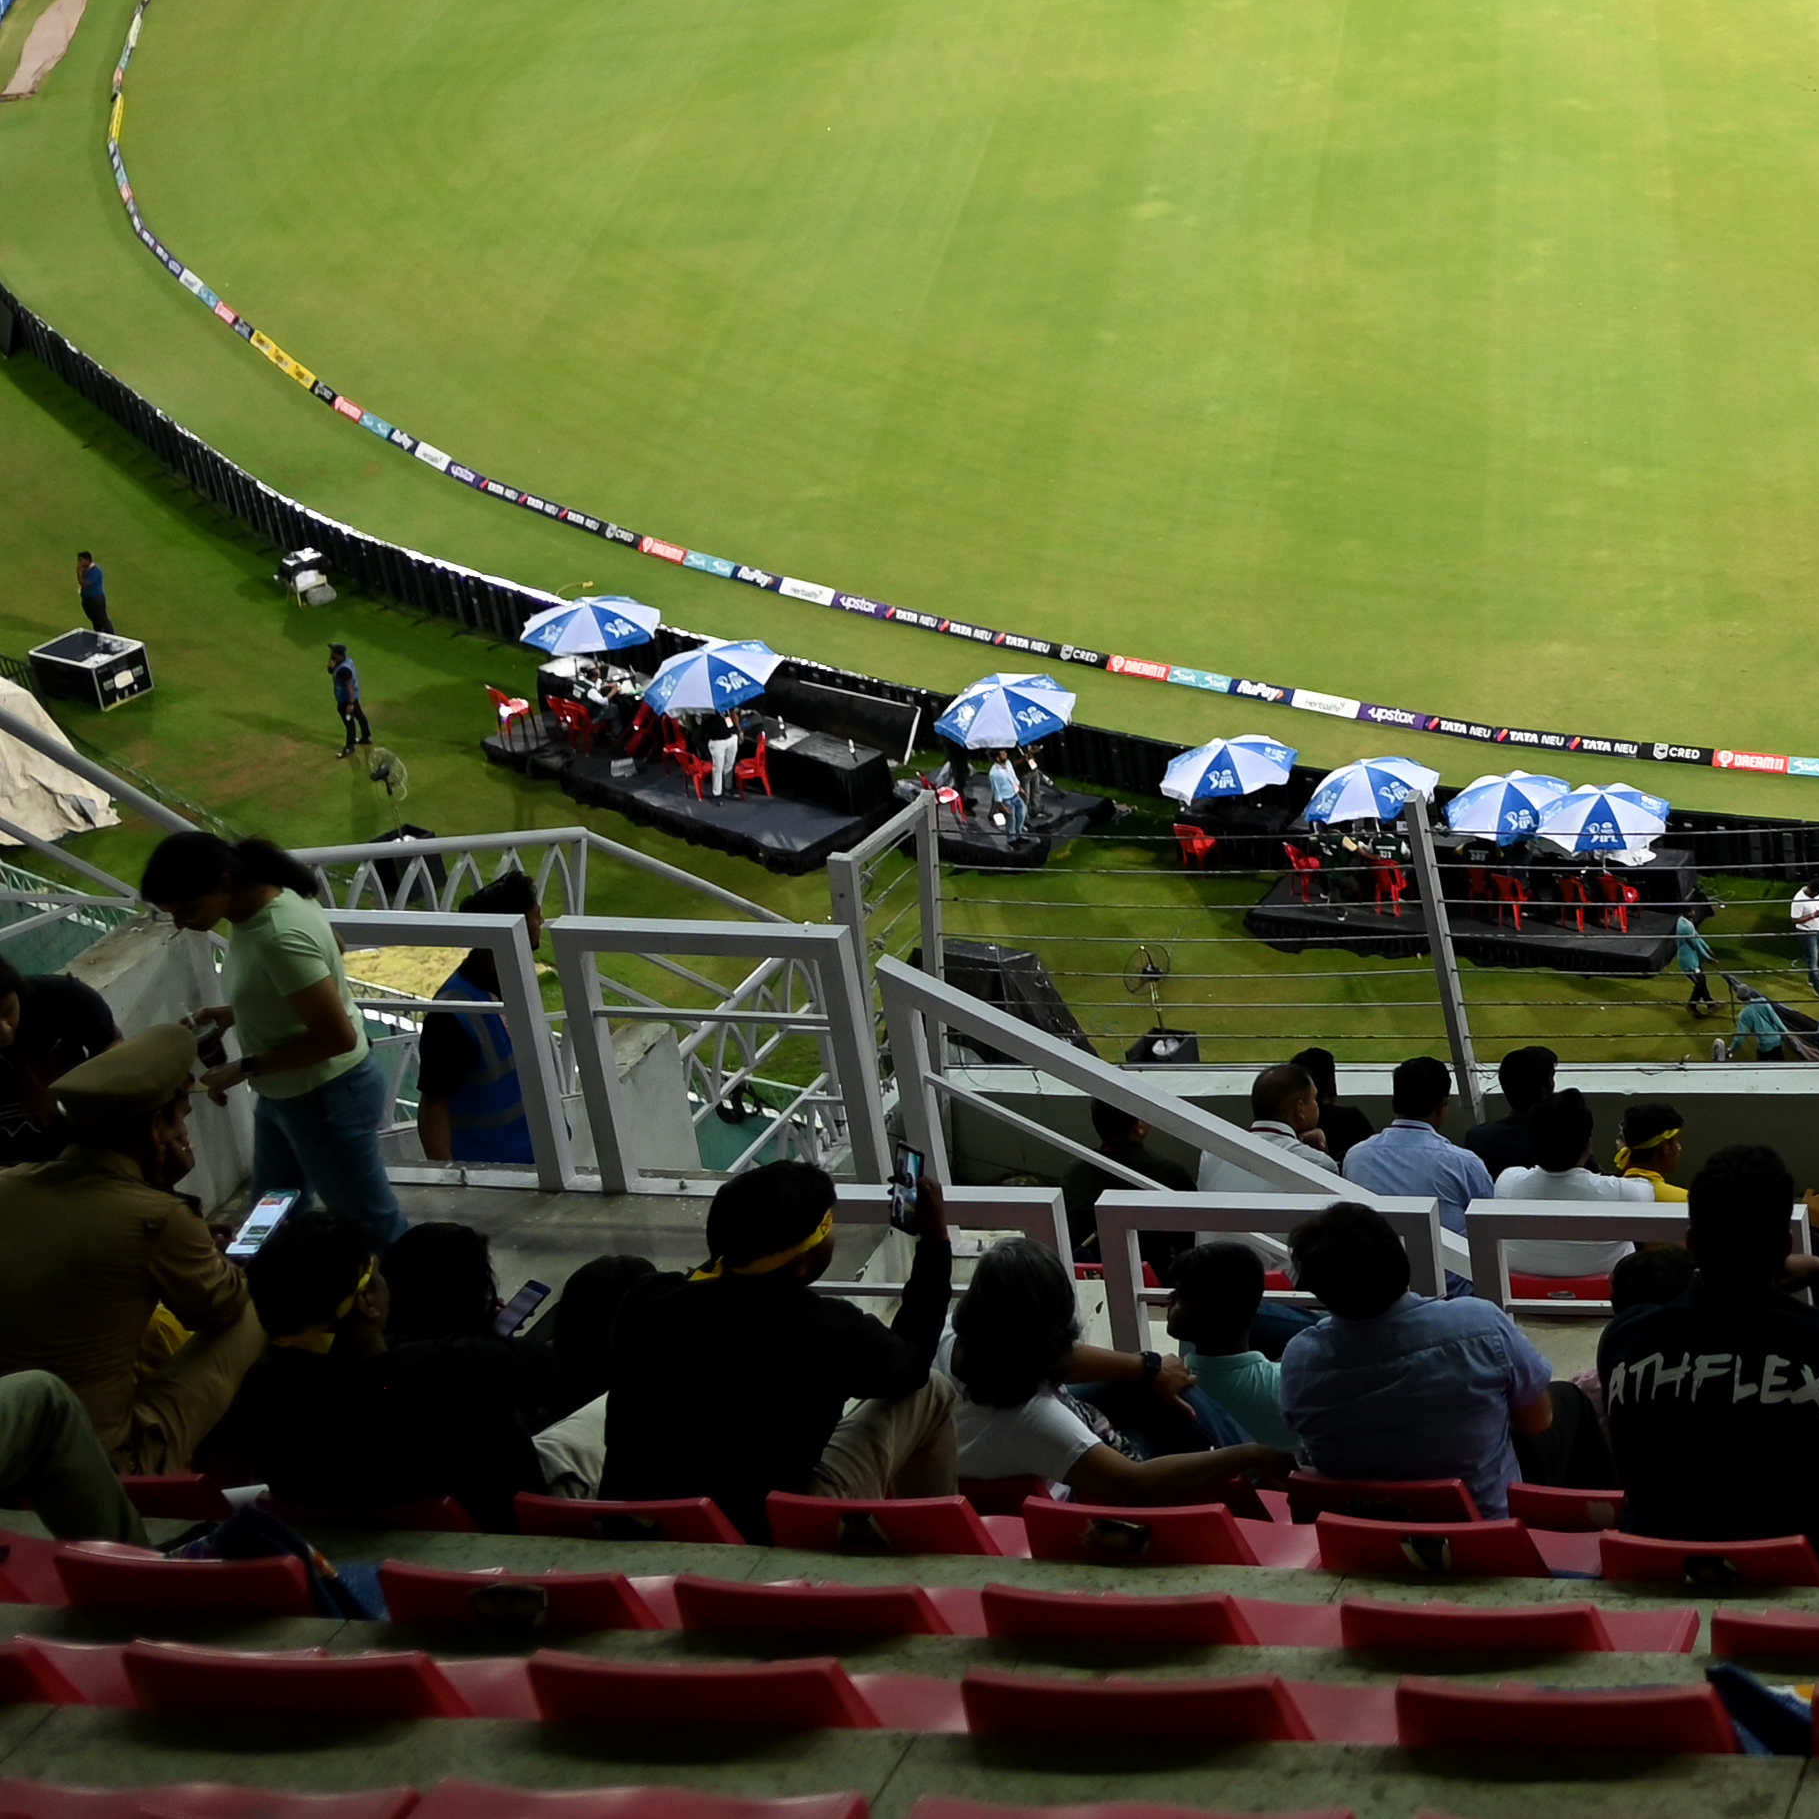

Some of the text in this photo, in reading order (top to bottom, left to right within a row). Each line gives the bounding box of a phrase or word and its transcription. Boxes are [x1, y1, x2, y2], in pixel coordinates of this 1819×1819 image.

[895, 609, 918, 623] TATA
[949, 623, 972, 639] TATA
[1005, 635, 1029, 650] TATA
[1073, 649, 1098, 664] CRED
[1236, 680, 1278, 702] RuPay
[1369, 707, 1416, 725] upstox
[1440, 719, 1491, 738] TATA NEU
[1509, 730, 1565, 747] TATA NEU
[1582, 738, 1638, 755] TATA NEU
[1669, 746, 1700, 760] CRED
[1735, 754, 1785, 770] DREAM11
[1219, 775, 1237, 789] IPL
[1518, 817, 1539, 830] IPL
